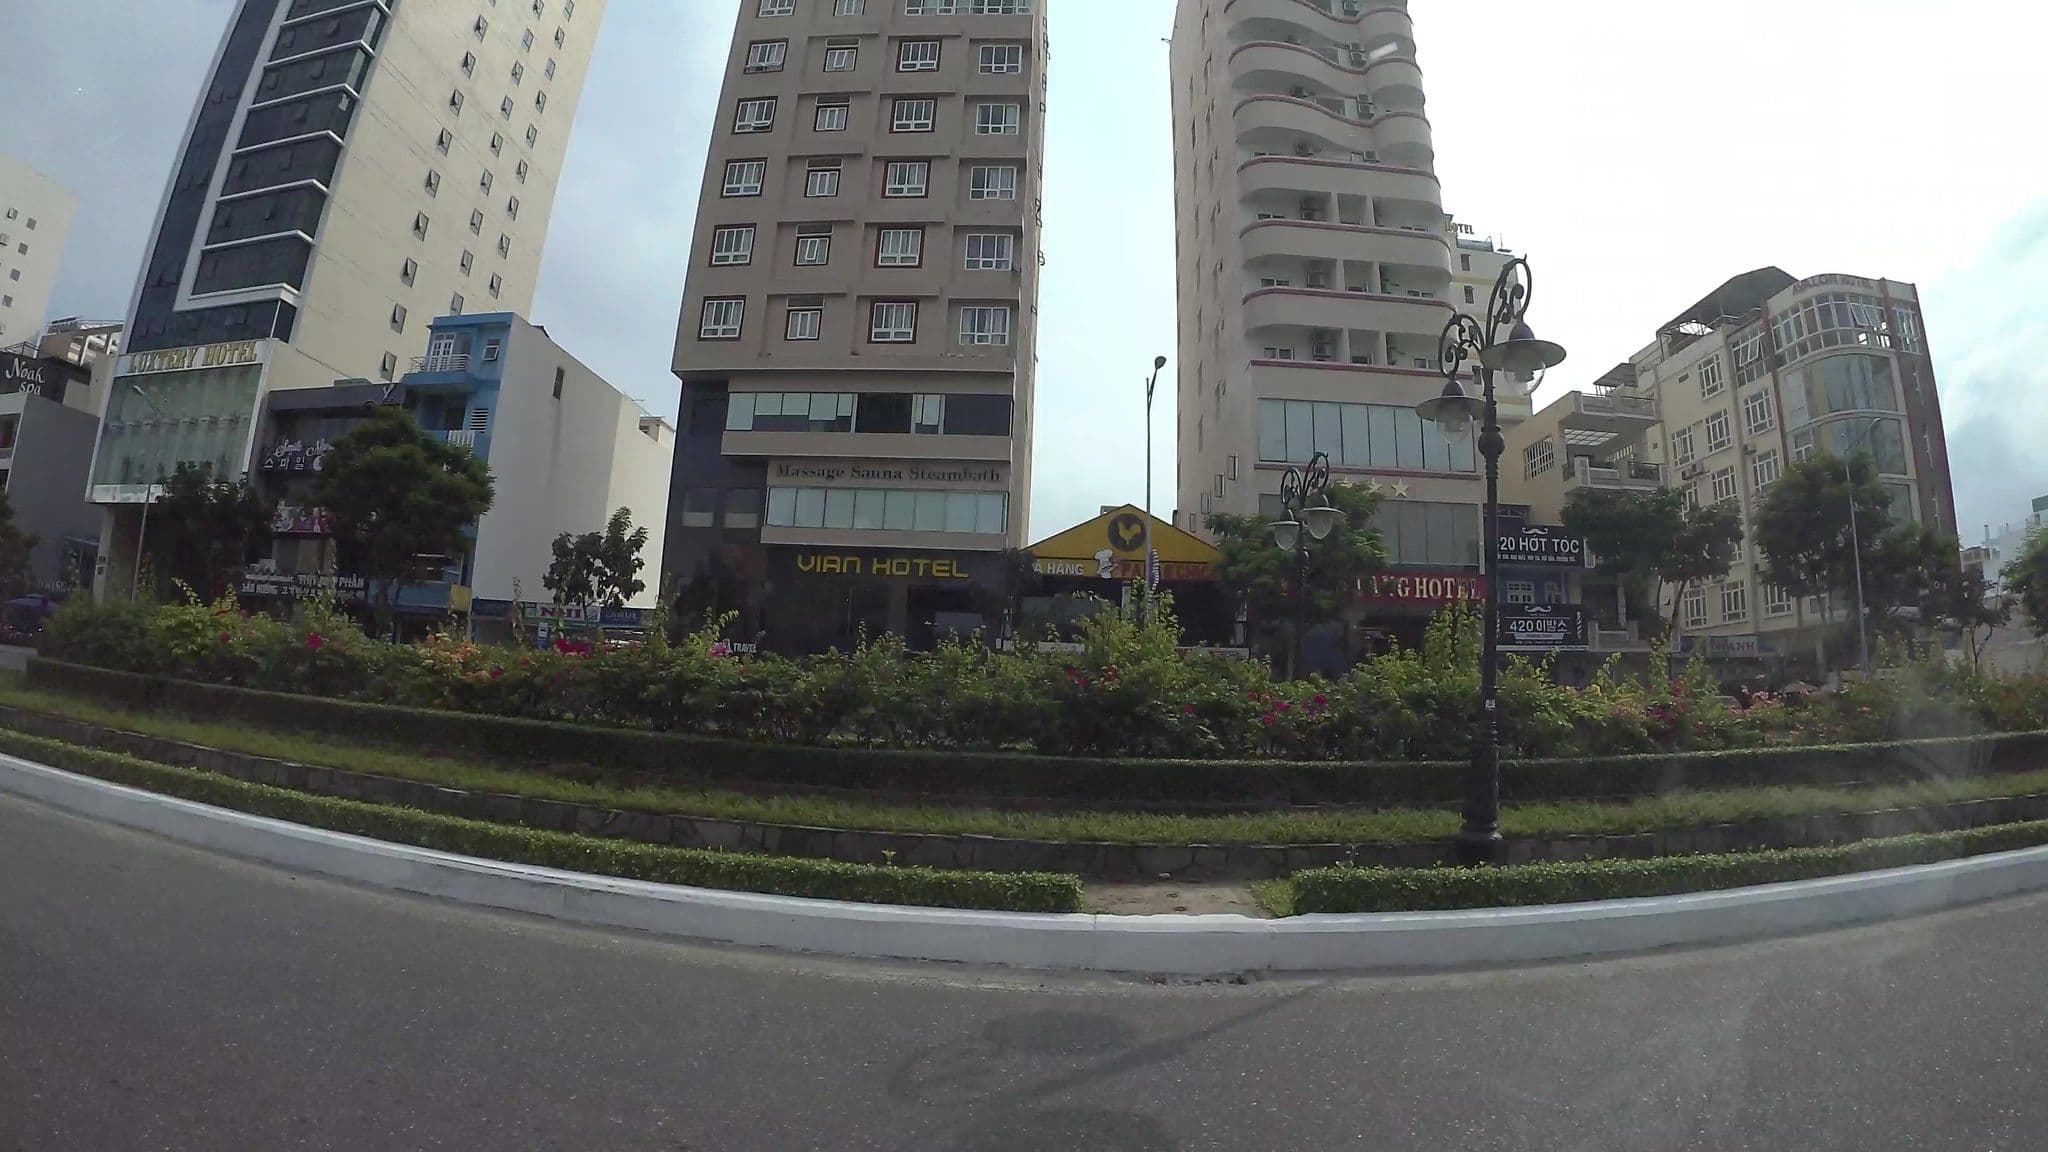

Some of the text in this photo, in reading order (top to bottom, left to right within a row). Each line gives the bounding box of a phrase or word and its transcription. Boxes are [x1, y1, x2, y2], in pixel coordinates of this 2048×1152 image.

[201, 341, 258, 366] HOTEL
[5, 357, 45, 384] Noah
[776, 463, 1001, 482] Massage Sauna Steambath
[1497, 536, 1516, 551] 20
[1551, 535, 1580, 553] TÓC
[796, 553, 970, 579] VIAN HOTEL
[1509, 620, 1534, 632] 420
[733, 642, 758, 653] TRAVEL
